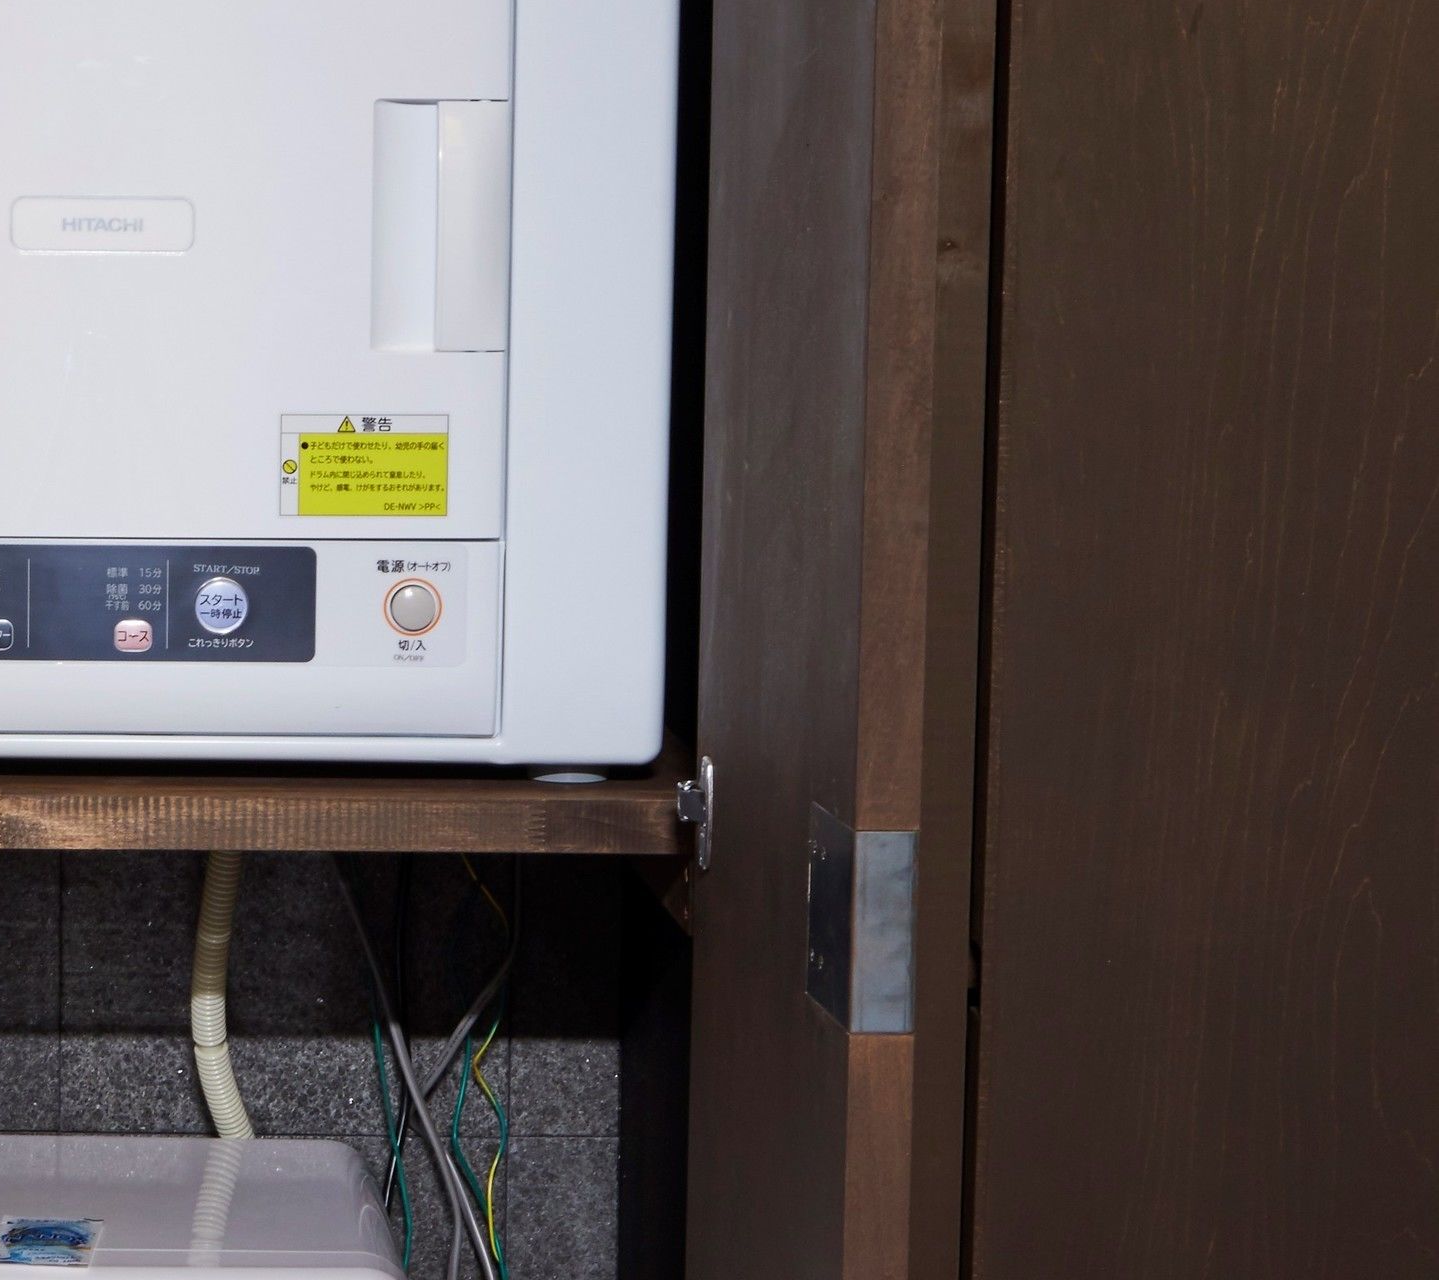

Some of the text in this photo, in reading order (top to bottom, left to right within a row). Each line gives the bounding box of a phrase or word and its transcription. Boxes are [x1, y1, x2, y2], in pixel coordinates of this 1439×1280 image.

[62, 218, 143, 232] HITACHI
[362, 417, 392, 432] 警告
[310, 455, 373, 464] ところで使わない。
[139, 567, 161, 578] 15分
[138, 584, 161, 595] 30分
[138, 600, 161, 611] 60分
[200, 594, 243, 607] スタート
[200, 608, 242, 620] 一時停止
[117, 631, 150, 642] コース
[188, 638, 254, 649] これっきりボタン
